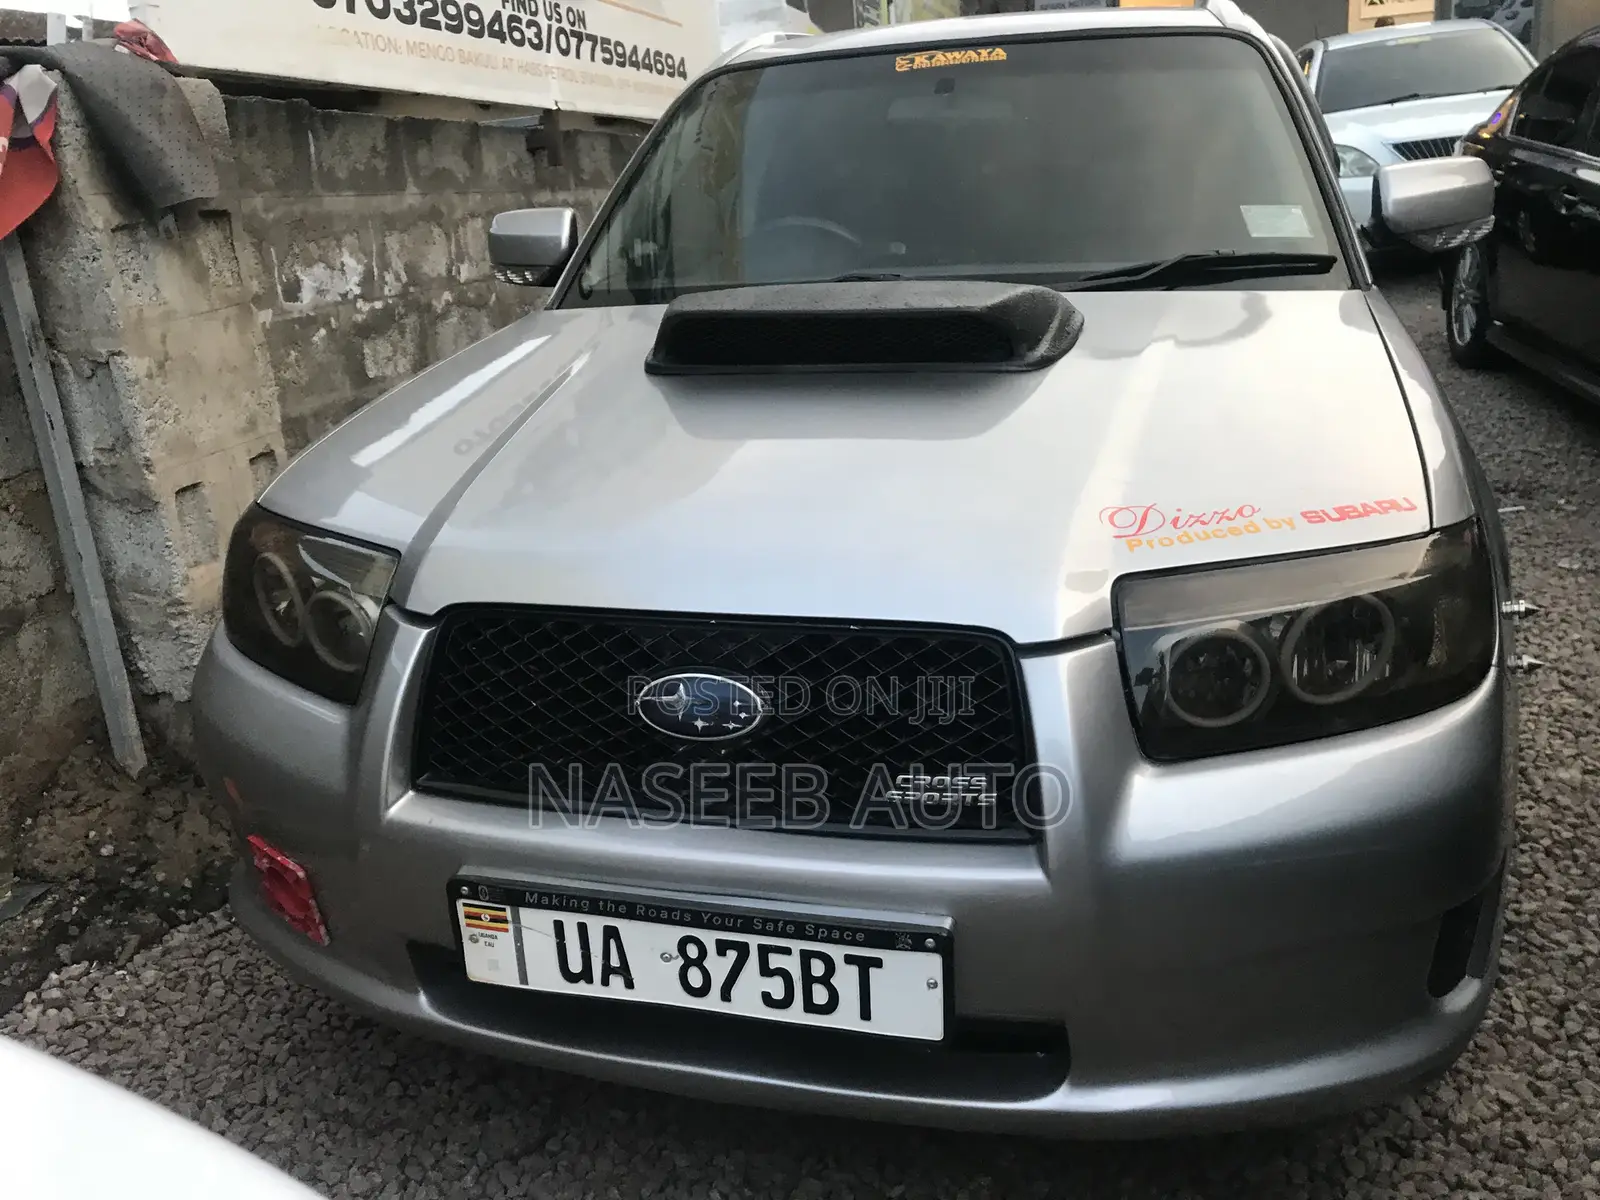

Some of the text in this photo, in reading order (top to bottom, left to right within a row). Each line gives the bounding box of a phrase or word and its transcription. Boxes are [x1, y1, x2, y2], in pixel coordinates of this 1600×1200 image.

[543, 0, 563, 24] US
[566, 6, 587, 31] ON
[313, 0, 688, 81] 03299463/0775944694
[1099, 503, 1261, 539] Dizzo
[1126, 496, 1418, 553] Produced by SUBARU
[885, 790, 998, 806] SPORTS
[895, 775, 988, 790] CROSS
[525, 891, 866, 942] Making the Roads Your Safe Space
[553, 919, 884, 1021] UA 875BT
